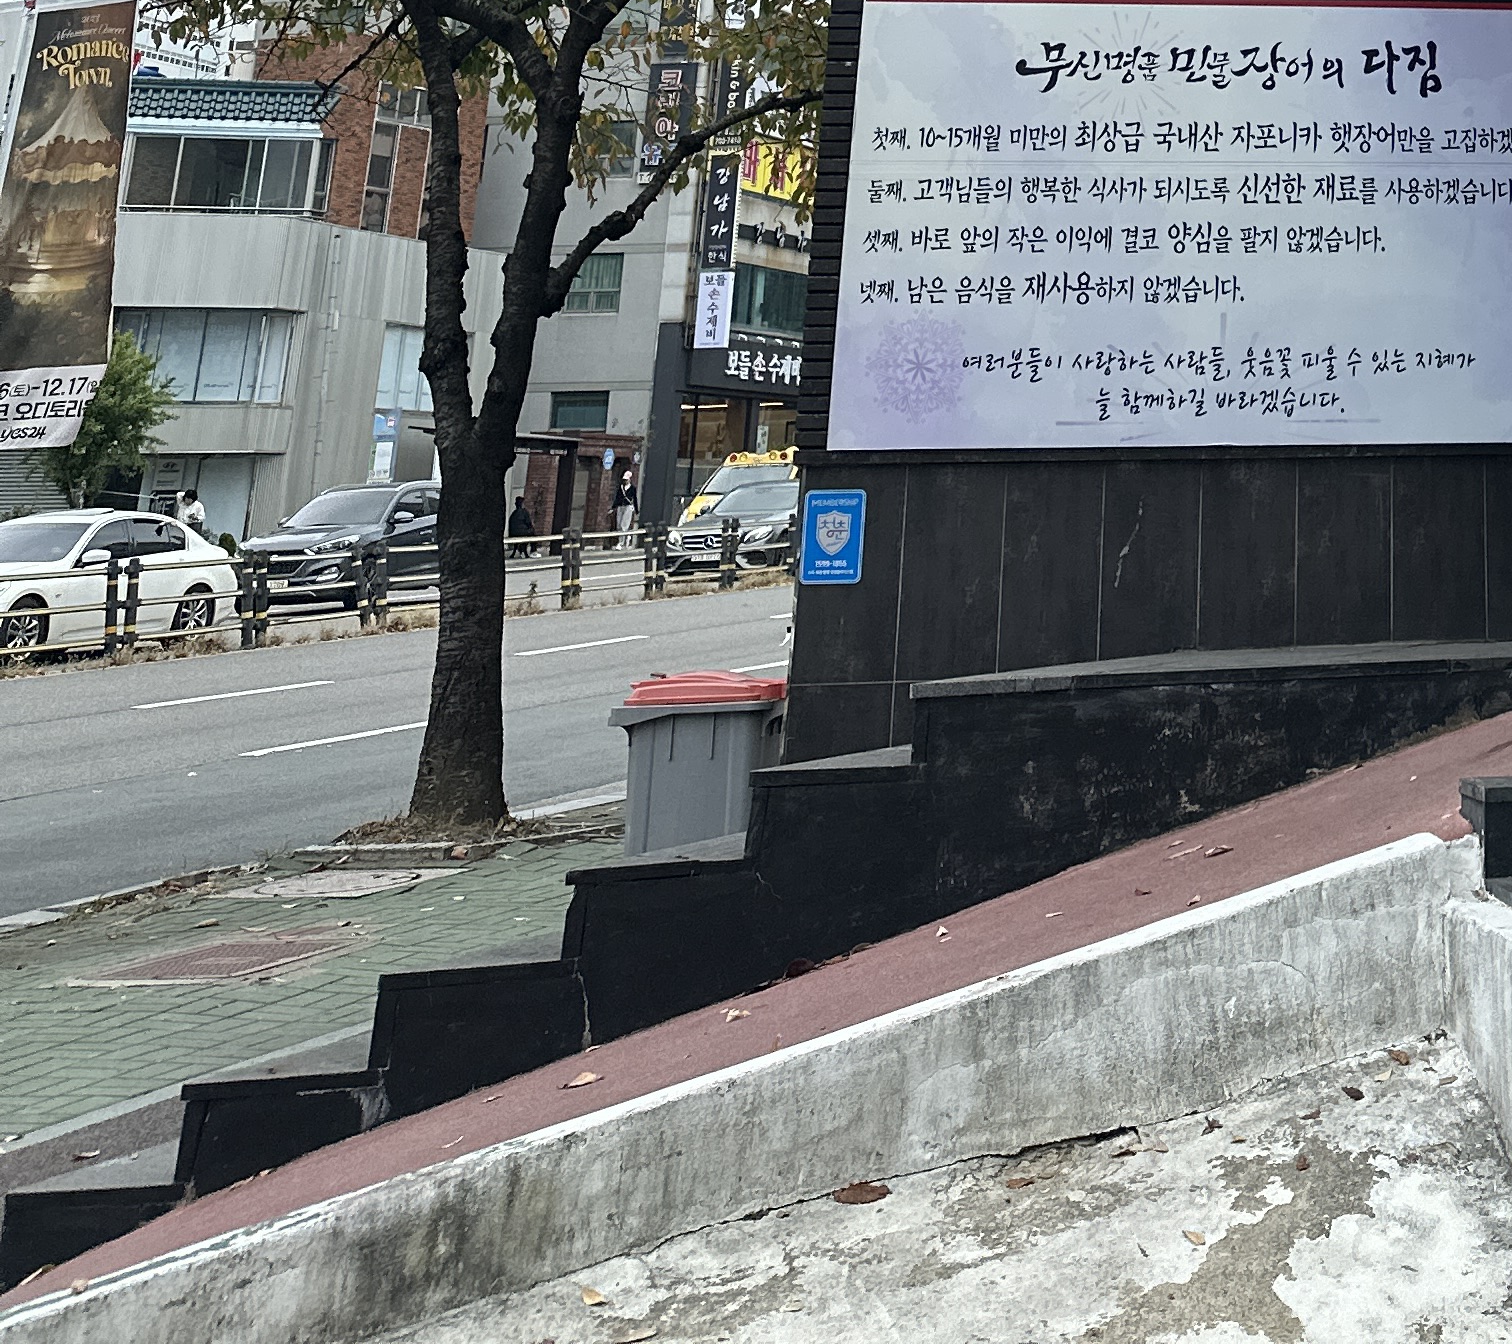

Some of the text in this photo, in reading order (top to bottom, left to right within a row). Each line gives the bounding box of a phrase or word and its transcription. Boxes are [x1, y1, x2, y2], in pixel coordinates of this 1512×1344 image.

[36, 37, 130, 71] Romance
[1015, 41, 1161, 93] 무신명품
[1361, 40, 1443, 99] 다짐
[58, 60, 113, 90] Town
[871, 124, 911, 152] 첫째.
[918, 123, 1002, 153] 10~15개월
[1009, 123, 1067, 153] 미만의
[1074, 120, 1145, 154] 최상급
[1152, 121, 1224, 154] 국내산
[1230, 121, 1323, 154] 자포니카
[1330, 121, 1435, 154] 햇장어만을
[867, 179, 907, 204] 둘째.
[913, 176, 1012, 204] 고객님들의
[1020, 176, 1082, 204] 행복한
[1087, 176, 1148, 204] 식사가
[1153, 176, 1231, 204] 되시도록
[1236, 172, 1307, 205] 신선한
[1313, 172, 1379, 205] 재료를
[862, 221, 1387, 255] 셋째. 바로 앞의 작은 이익에 결코 양심을 팔지 않겠습니다.
[859, 270, 1245, 305] 넷째. 남은 음식을 재사용하지 않겠습니다.
[962, 344, 1477, 383] 여러분들이 사랑하는 사람들, 웃음꽃 피울 수 있는 지혜가
[1095, 387, 1346, 421] 늘 함께하길 바라겠습니다.
